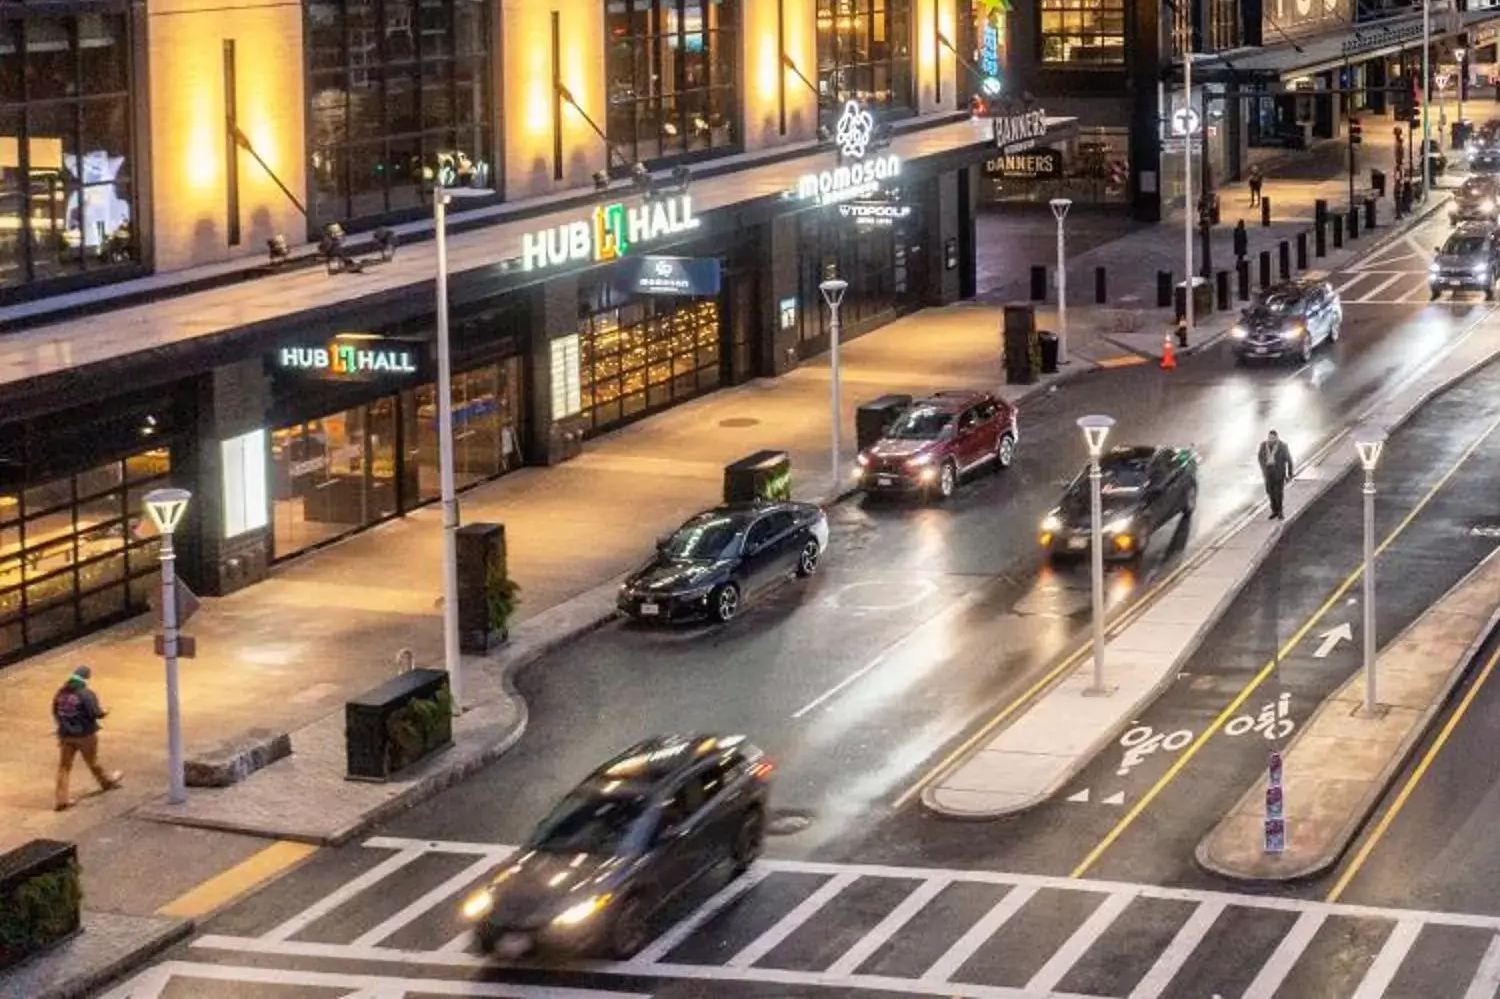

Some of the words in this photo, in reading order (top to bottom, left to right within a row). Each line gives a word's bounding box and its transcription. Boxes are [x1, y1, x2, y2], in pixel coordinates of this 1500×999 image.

[797, 155, 902, 200] momosan
[522, 221, 590, 272] HUB
[628, 195, 701, 244] HALL
[280, 346, 329, 368] HUB
[357, 350, 417, 372] HALL
